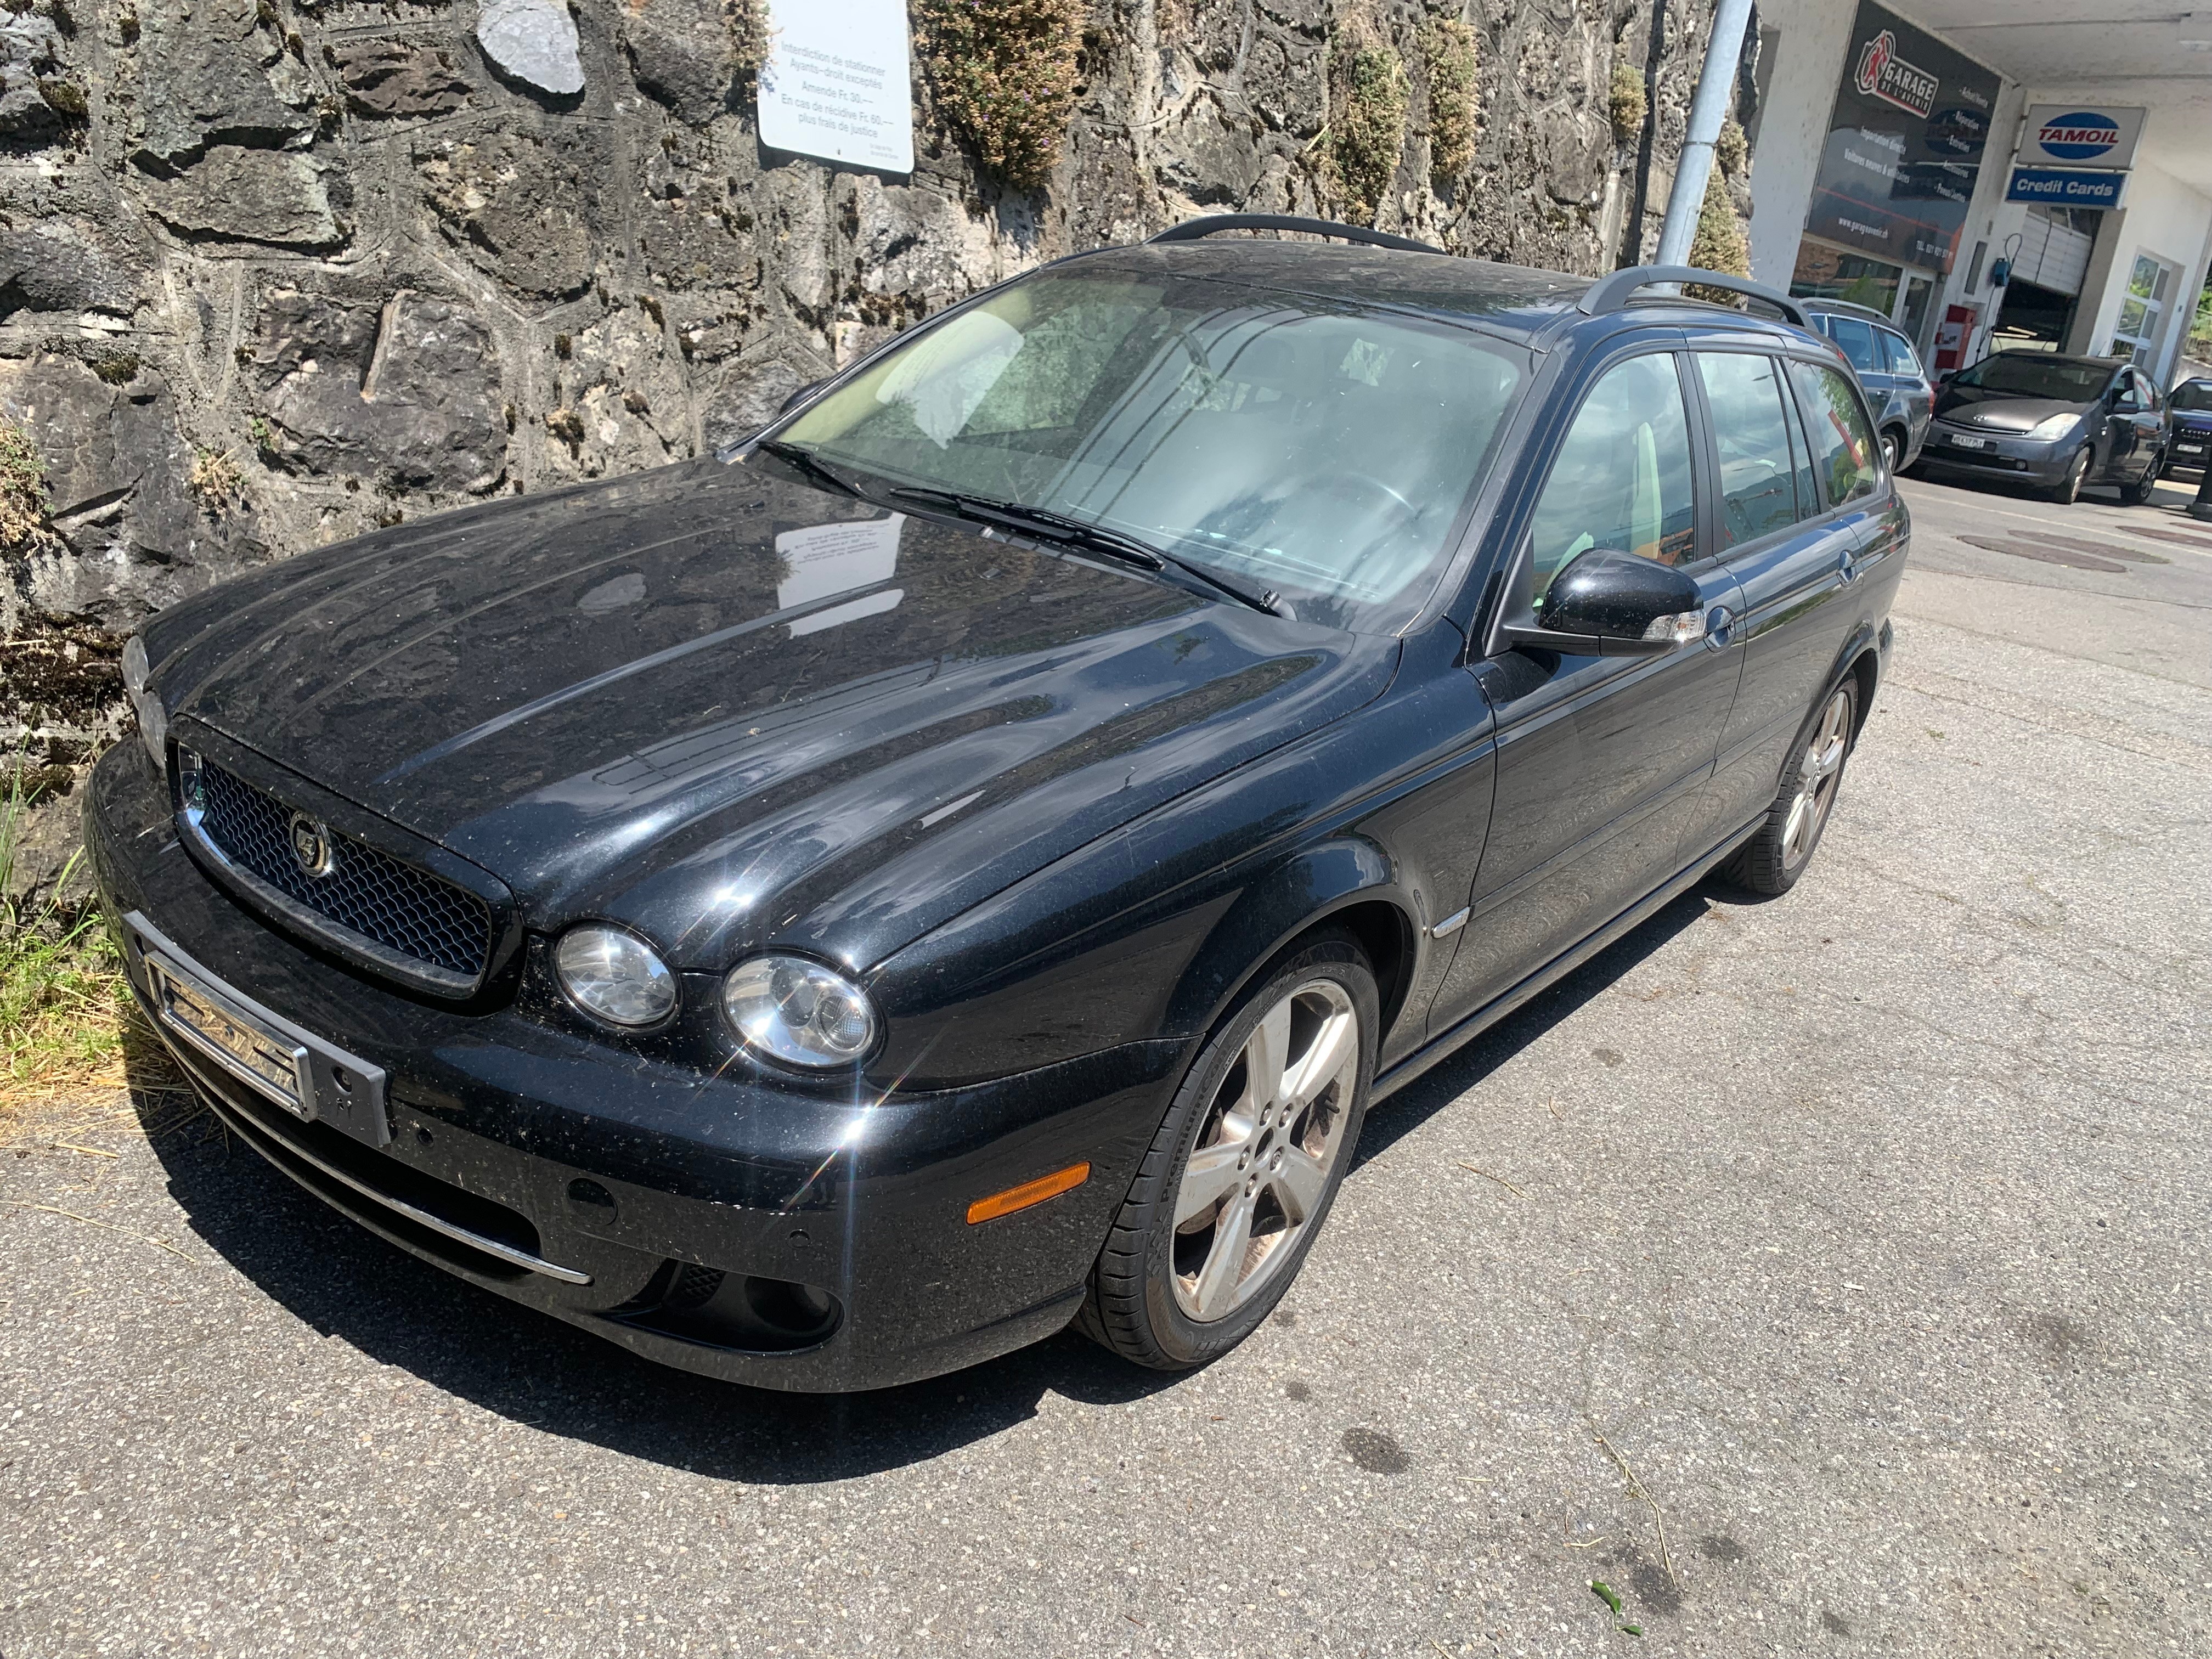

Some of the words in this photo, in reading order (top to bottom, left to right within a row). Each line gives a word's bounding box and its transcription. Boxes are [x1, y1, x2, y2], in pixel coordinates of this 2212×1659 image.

[781, 41, 830, 63] Interdiction
[832, 55, 843, 66] de
[844, 59, 885, 76] stationner
[790, 58, 844, 81] Ayants-droit
[845, 74, 883, 89] exceptés
[1884, 62, 1935, 100] GARAGE
[802, 81, 837, 98] Amende
[838, 89, 848, 100] Fr.
[1881, 81, 1892, 93] DE
[781, 93, 793, 105] En
[795, 99, 810, 109] cas
[812, 102, 823, 112] de
[825, 105, 857, 120] récidive
[859, 111, 869, 122] Fr.
[798, 112, 816, 125] plus
[818, 116, 836, 129] frais
[838, 122, 849, 132] de
[850, 123, 878, 138] justice
[2038, 128, 2119, 144] TAMOIL
[2016, 178, 2063, 193] Credit
[2067, 182, 2114, 196] Cards
